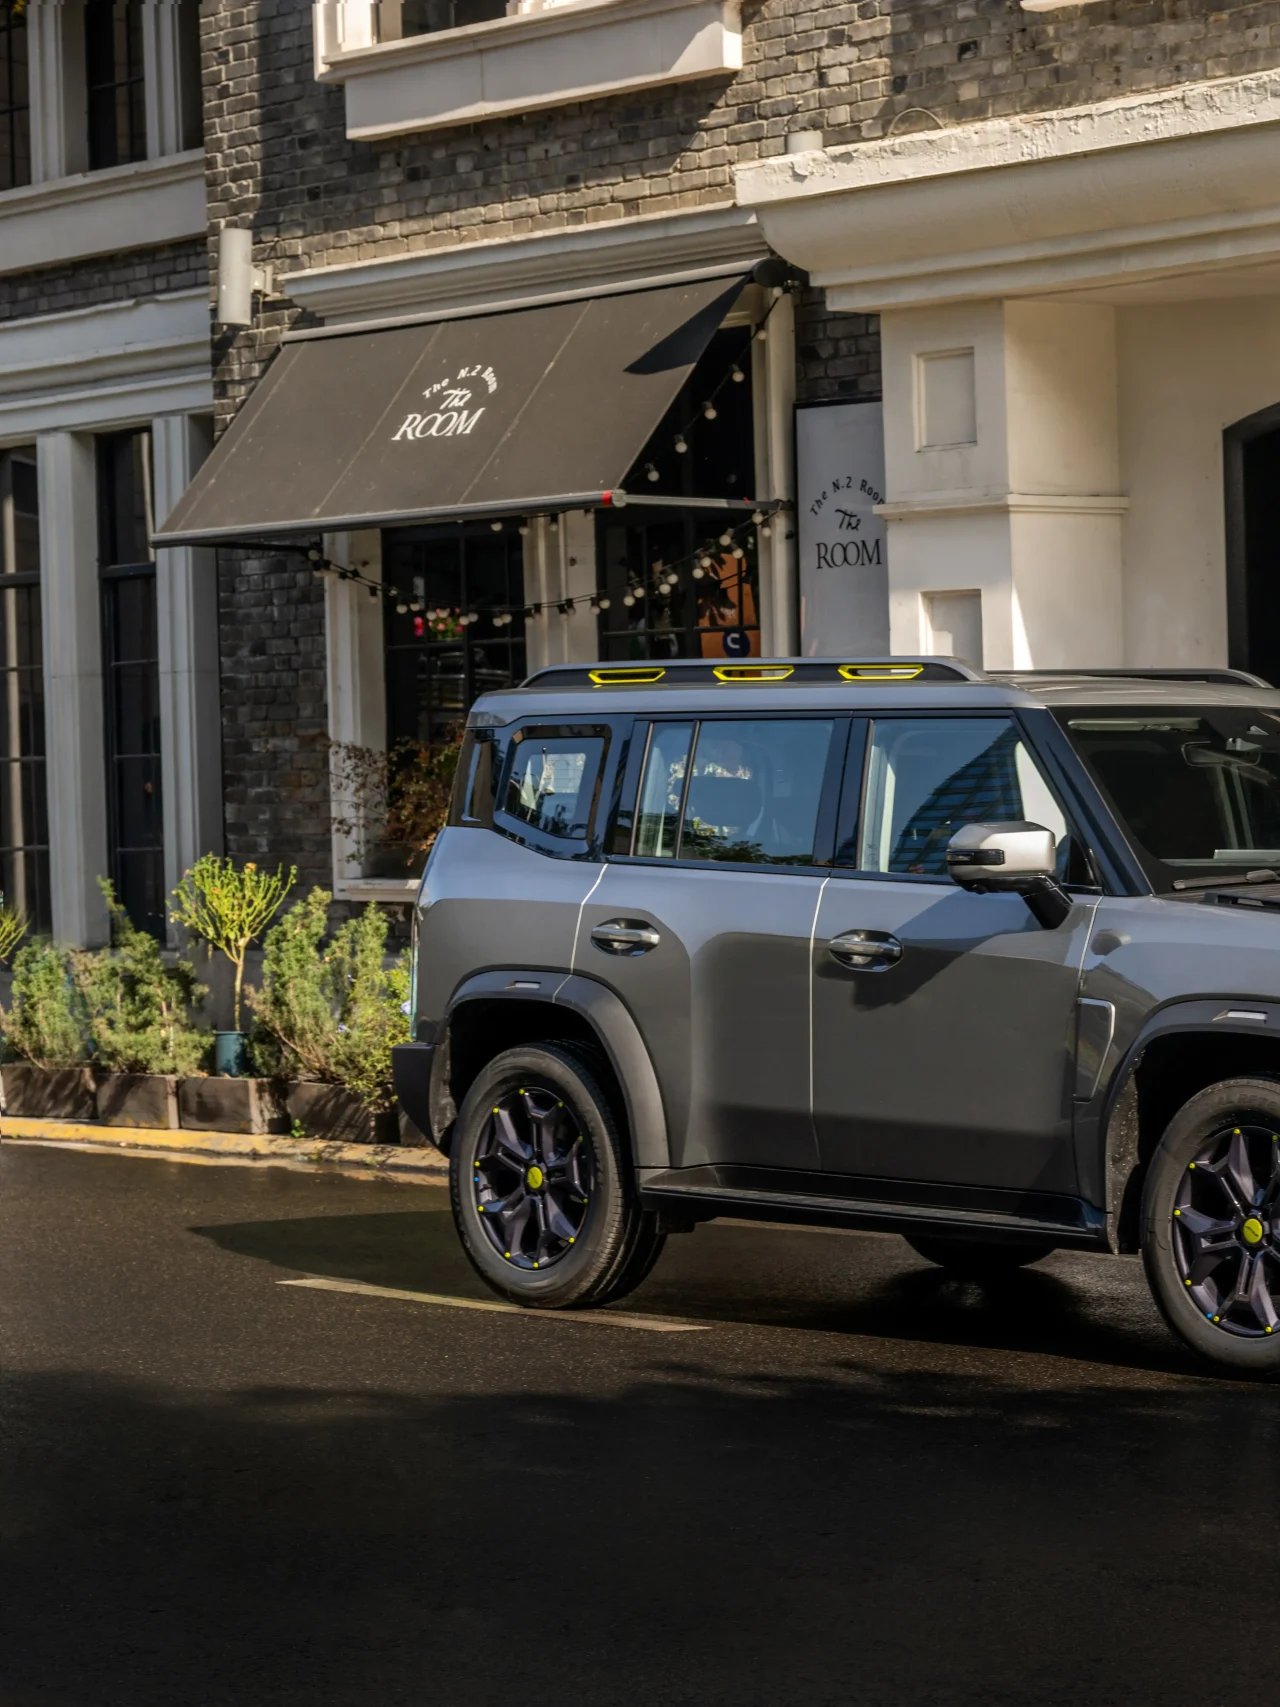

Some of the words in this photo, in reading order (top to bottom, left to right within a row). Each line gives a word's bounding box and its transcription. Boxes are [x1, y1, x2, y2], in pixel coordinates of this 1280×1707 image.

[422, 378, 449, 399] The
[456, 364, 482, 379] N.2
[439, 387, 472, 409] The
[390, 407, 486, 440] ROOM
[809, 491, 829, 516] The
[832, 476, 853, 493] N.2
[834, 509, 862, 531] The
[815, 538, 883, 569] ROOM
